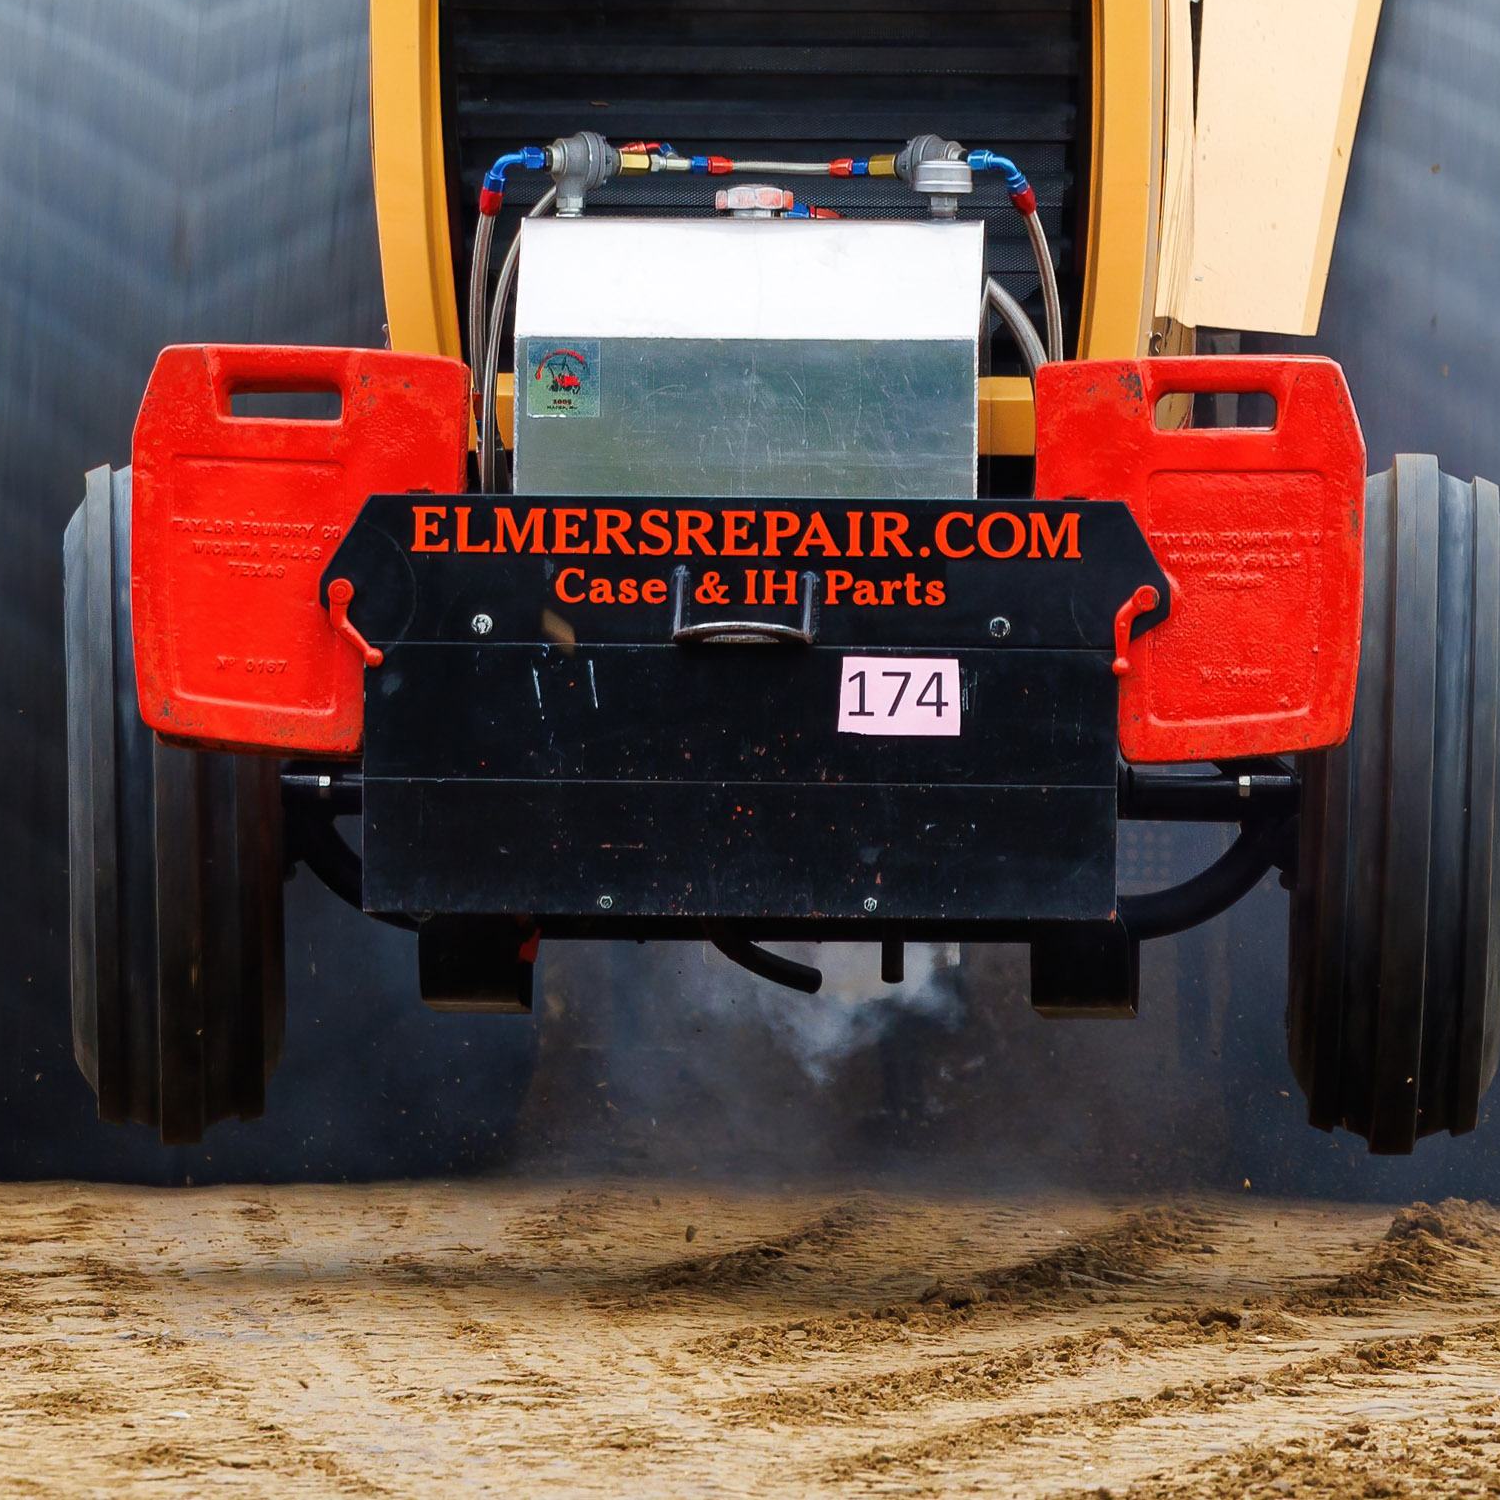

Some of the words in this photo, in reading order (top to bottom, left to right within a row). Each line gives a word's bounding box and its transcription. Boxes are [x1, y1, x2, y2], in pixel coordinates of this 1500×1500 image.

[172, 517, 235, 535] TAYLOR
[241, 521, 315, 540] FOUNDRY
[411, 506, 1082, 560] ELMERSREPAIR.COM
[192, 539, 261, 558] WICHITA
[270, 543, 323, 561] FALLS
[228, 561, 287, 579] TEXAS
[556, 568, 669, 605] Case
[695, 571, 731, 605] &
[744, 570, 798, 605] IH
[826, 571, 947, 606] Parts
[847, 670, 949, 717] 174
